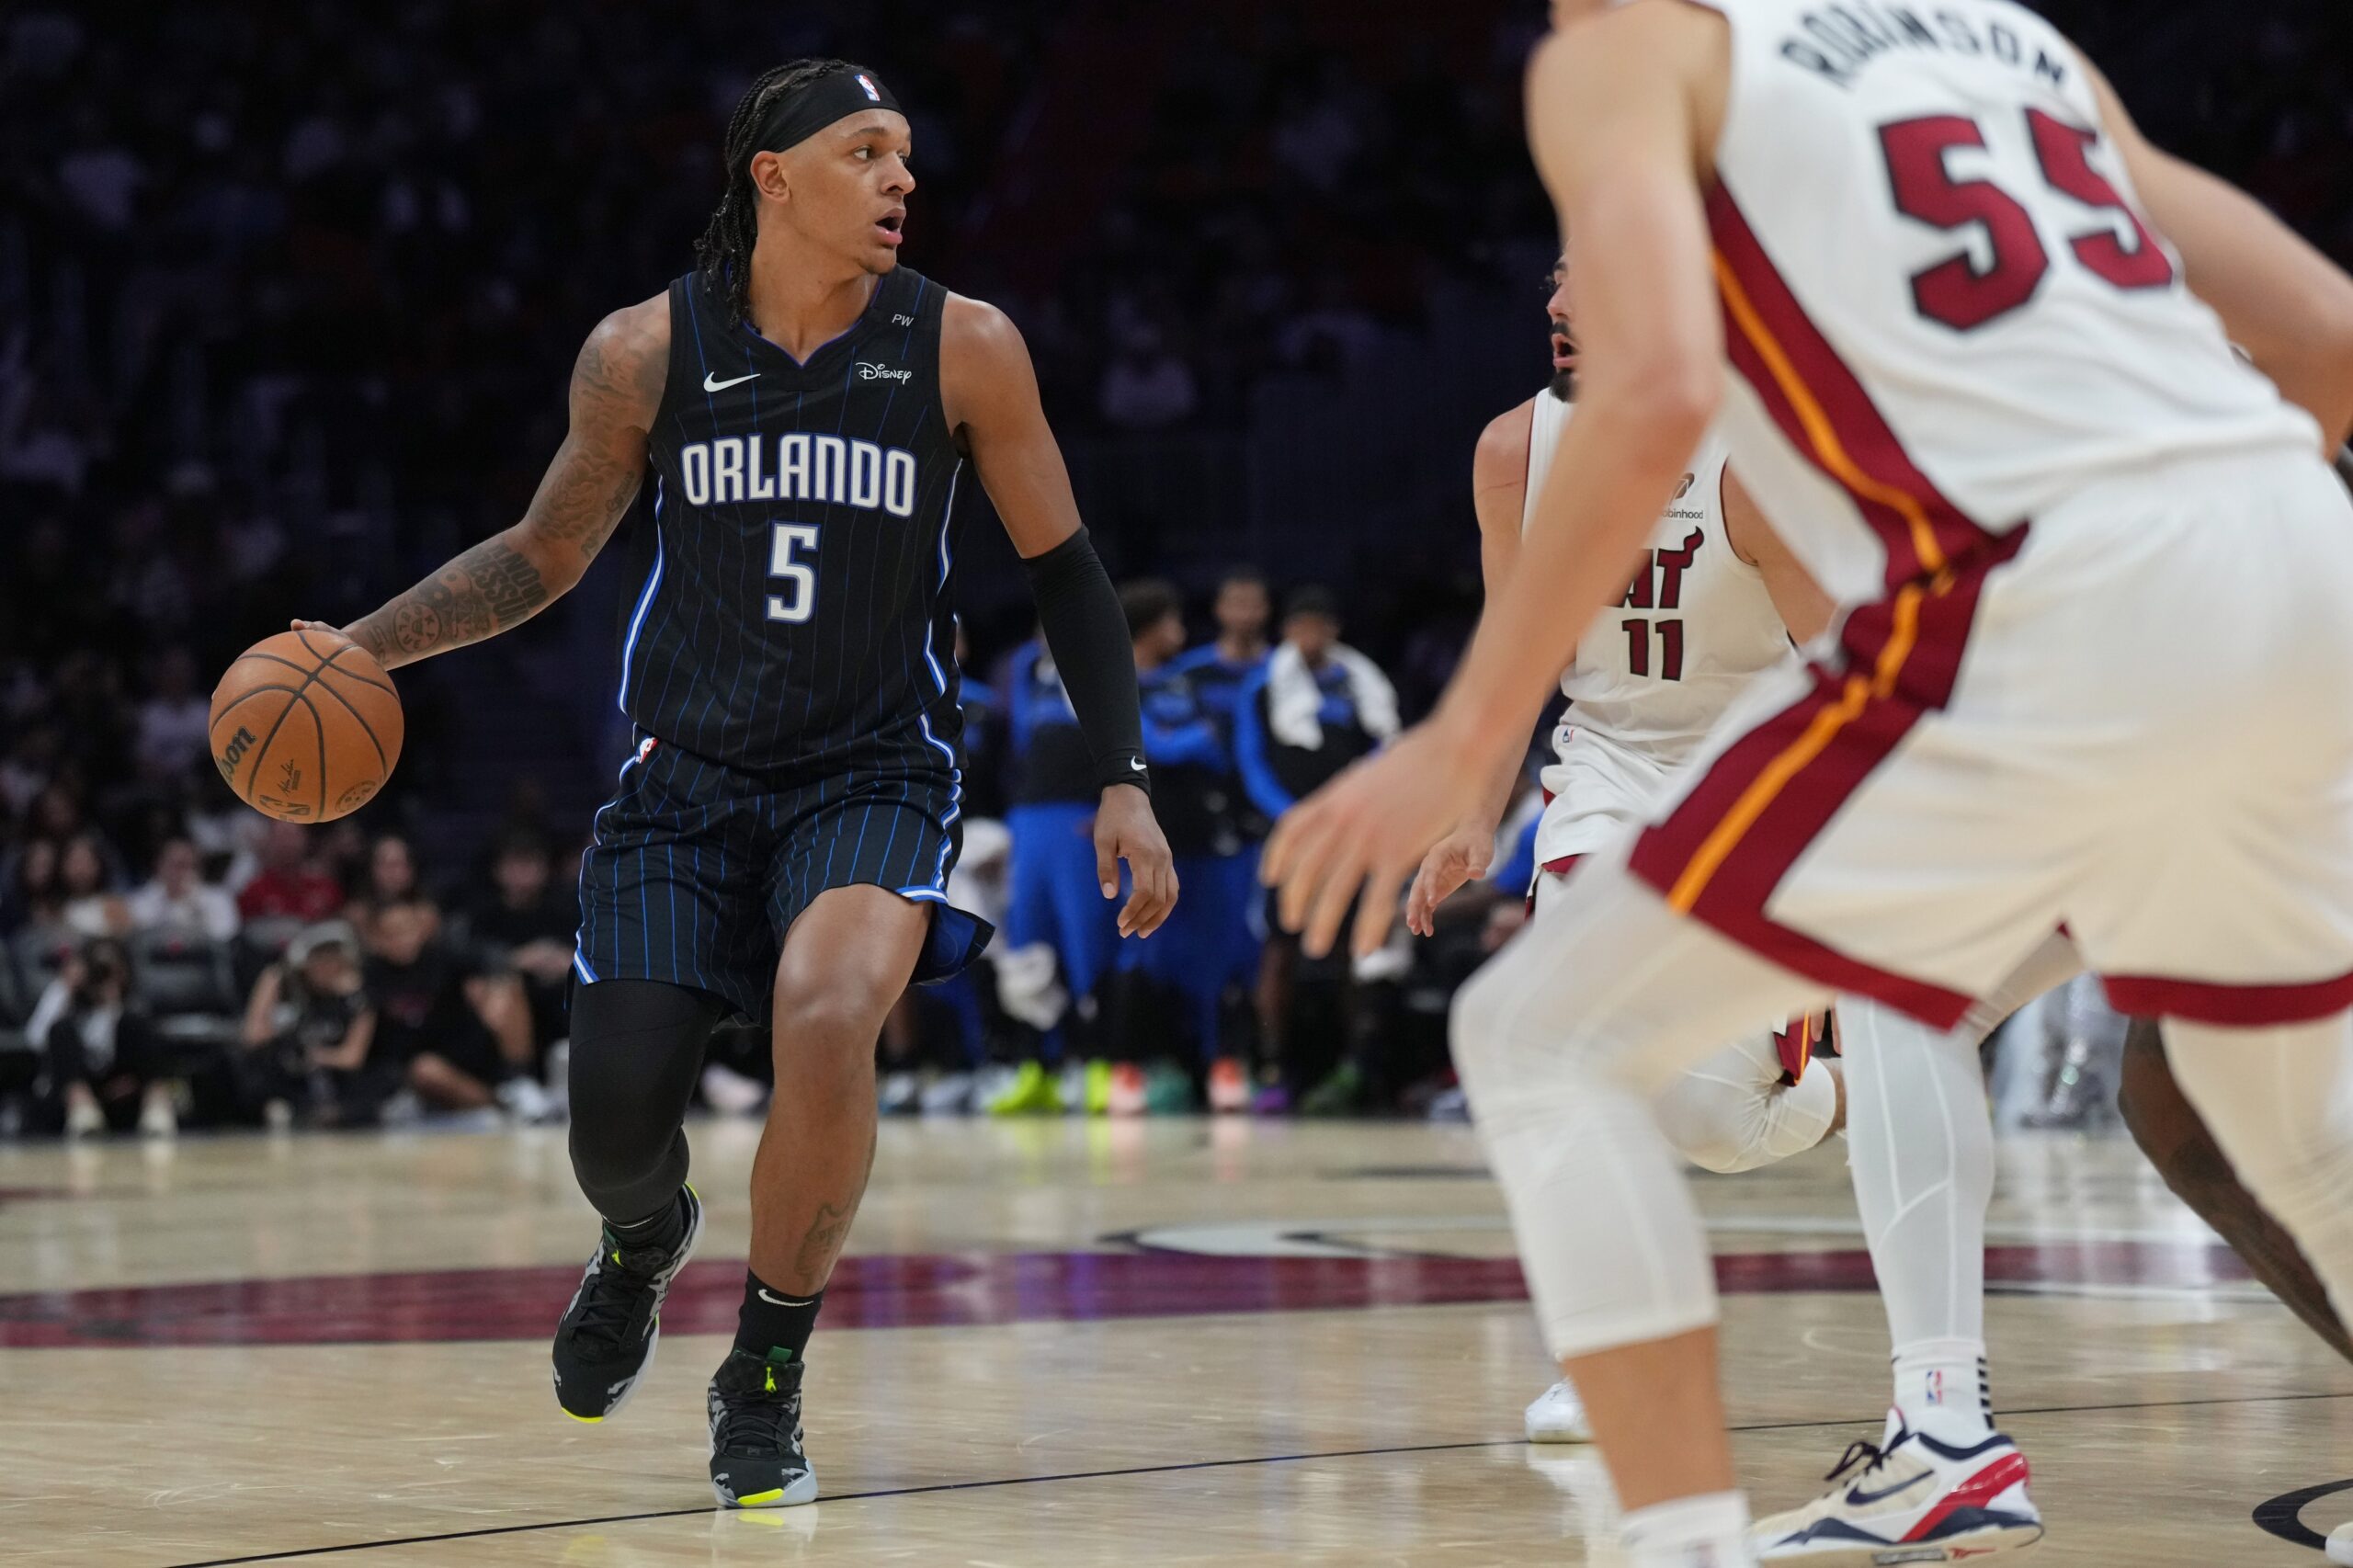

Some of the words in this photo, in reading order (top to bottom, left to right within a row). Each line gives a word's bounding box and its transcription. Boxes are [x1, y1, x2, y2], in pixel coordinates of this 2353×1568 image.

[1876, 106, 2174, 334] 55
[892, 313, 915, 327] PW
[855, 362, 912, 385] Disney
[680, 432, 916, 519] ORLANDO
[1662, 507, 1704, 519] obinhood
[764, 520, 821, 624] 5
[1609, 526, 1704, 609] AT
[1621, 619, 1684, 681] 11
[216, 725, 257, 787] son
